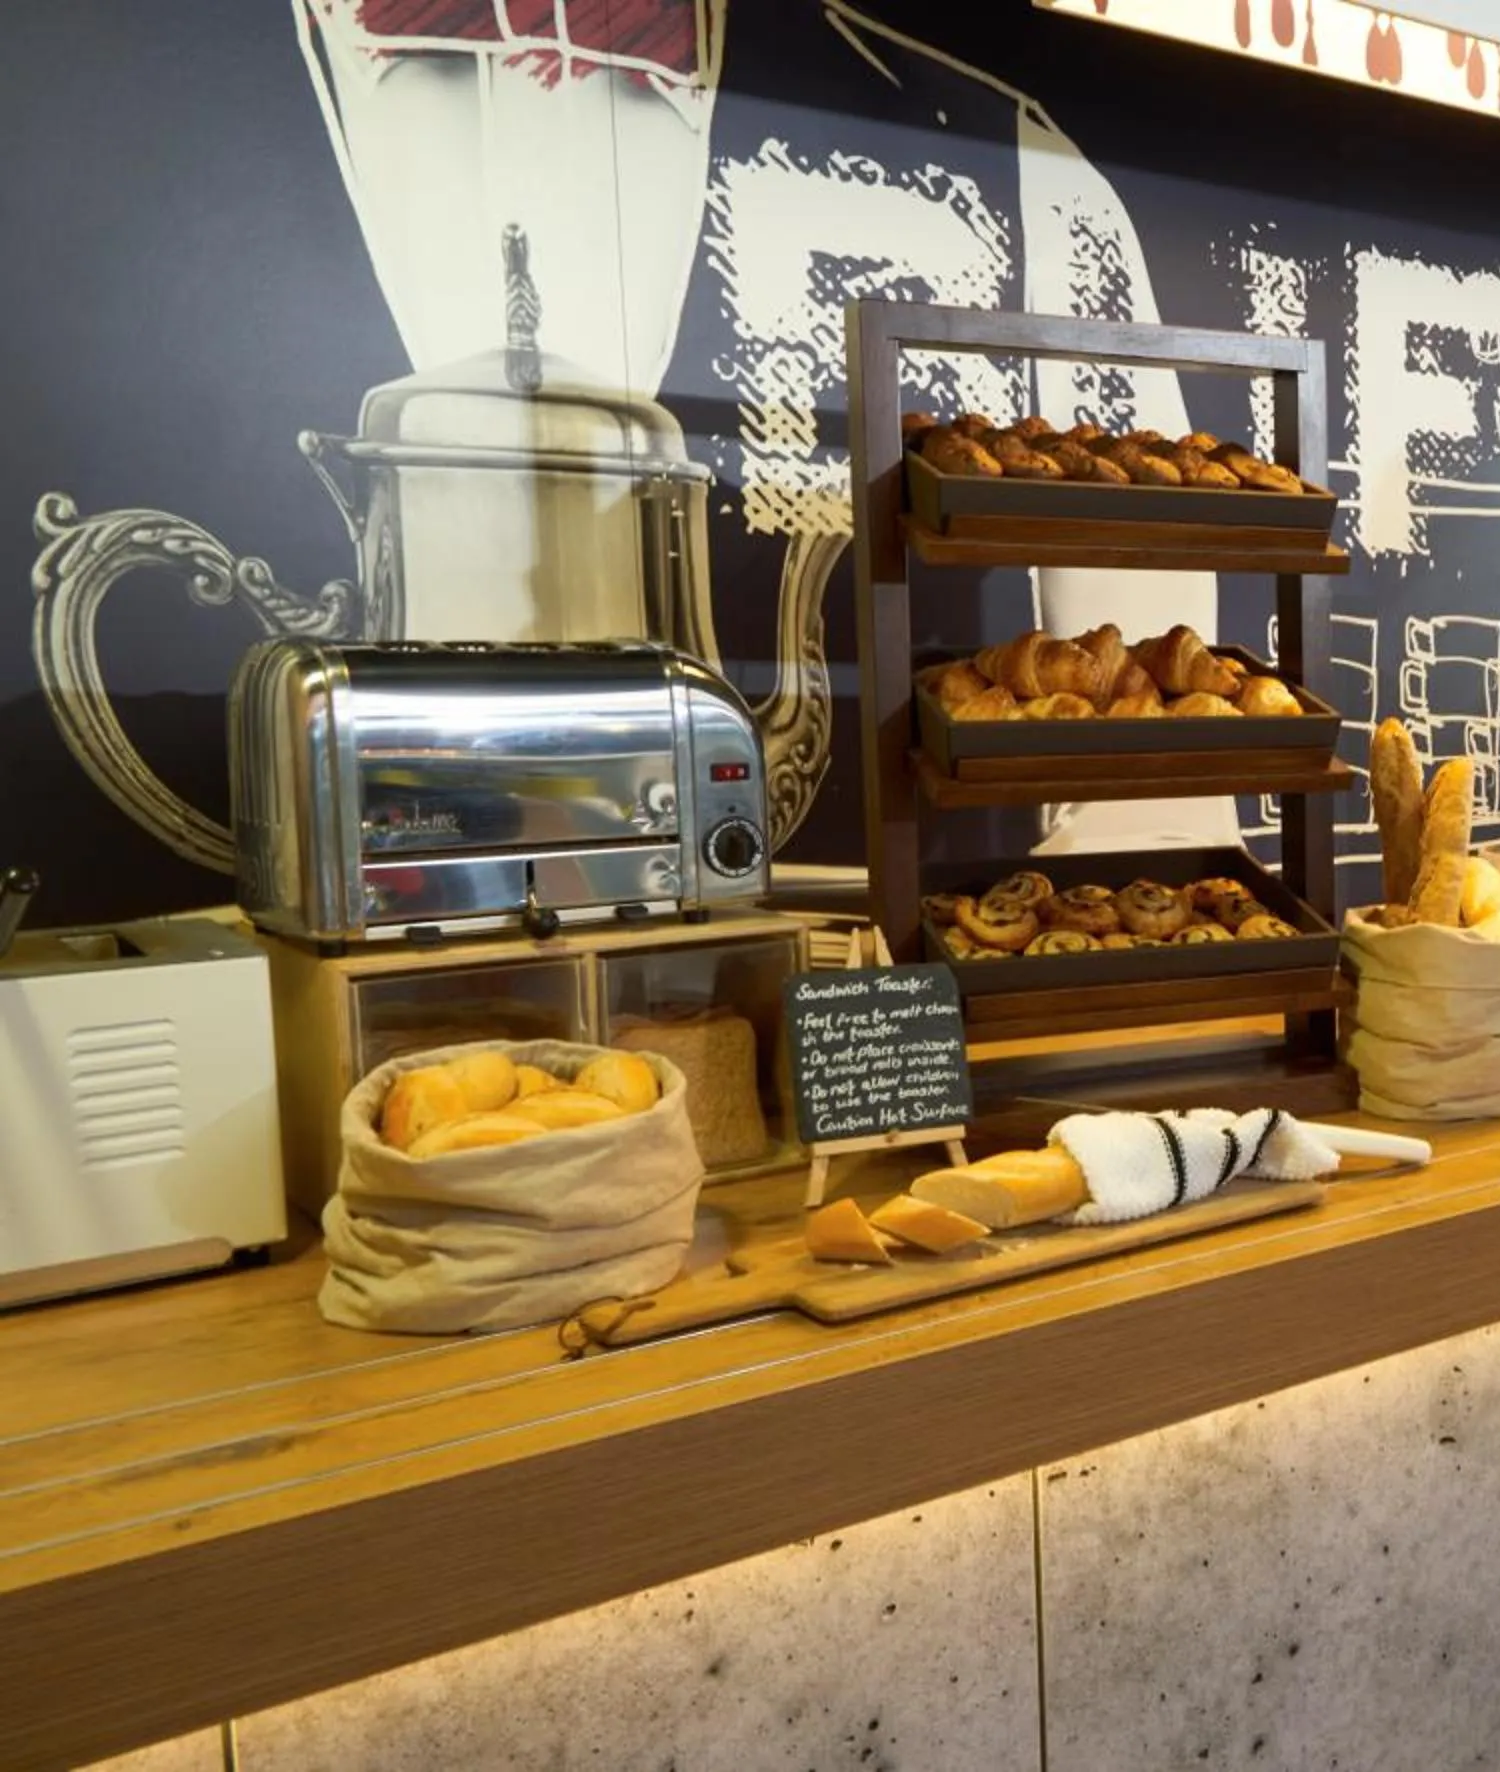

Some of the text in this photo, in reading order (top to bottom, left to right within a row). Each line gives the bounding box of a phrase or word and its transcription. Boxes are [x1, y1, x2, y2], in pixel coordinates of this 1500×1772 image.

[796, 981, 869, 1001] Sandwich
[803, 1011, 832, 1030] Feel
[837, 1014, 869, 1027] free
[871, 1007, 886, 1025] to
[810, 1050, 827, 1067] Do
[832, 1046, 856, 1063] not
[857, 1043, 895, 1063] place
[801, 1069, 818, 1082] or
[824, 1062, 869, 1079] bread
[811, 1084, 828, 1101] Do
[829, 1079, 856, 1097] not
[861, 1074, 901, 1092] allow
[812, 1100, 830, 1115] to
[868, 1090, 892, 1105] the
[816, 1101, 969, 1135] Caution Hot Surface
